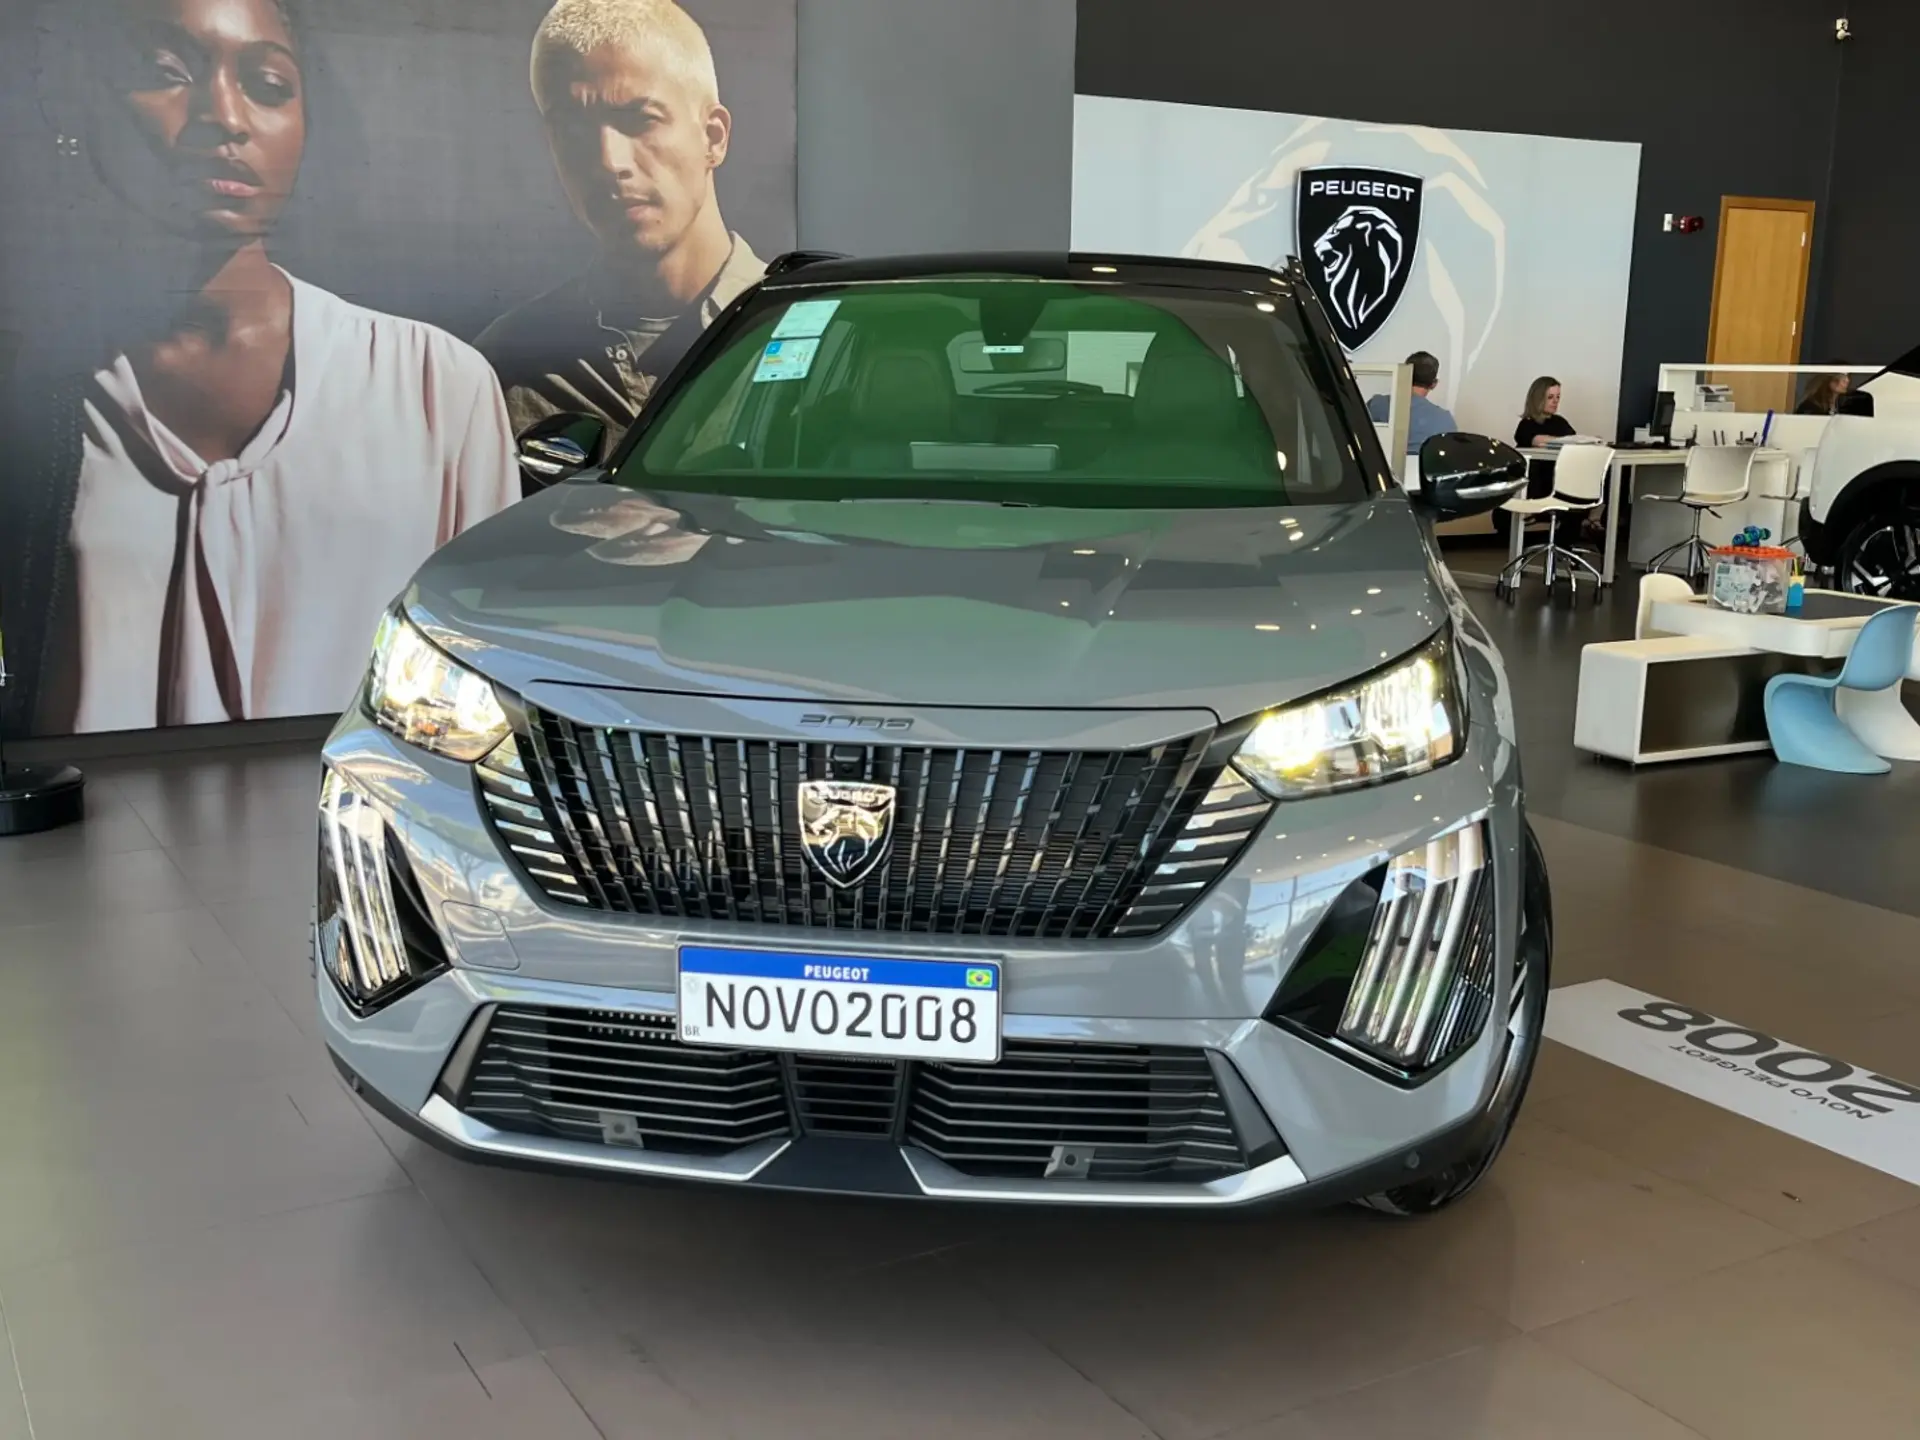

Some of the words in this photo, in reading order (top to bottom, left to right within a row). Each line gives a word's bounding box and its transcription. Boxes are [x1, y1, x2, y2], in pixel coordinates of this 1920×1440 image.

[1310, 180, 1415, 201] PEUGEOT
[799, 713, 915, 731] 2008
[804, 964, 871, 982] PEUGEOT
[705, 981, 977, 1044] NOVO2008
[1616, 1001, 1920, 1114] 2008
[1669, 1044, 1789, 1090] PEUGEOT
[1790, 1087, 1873, 1120] NOVO
